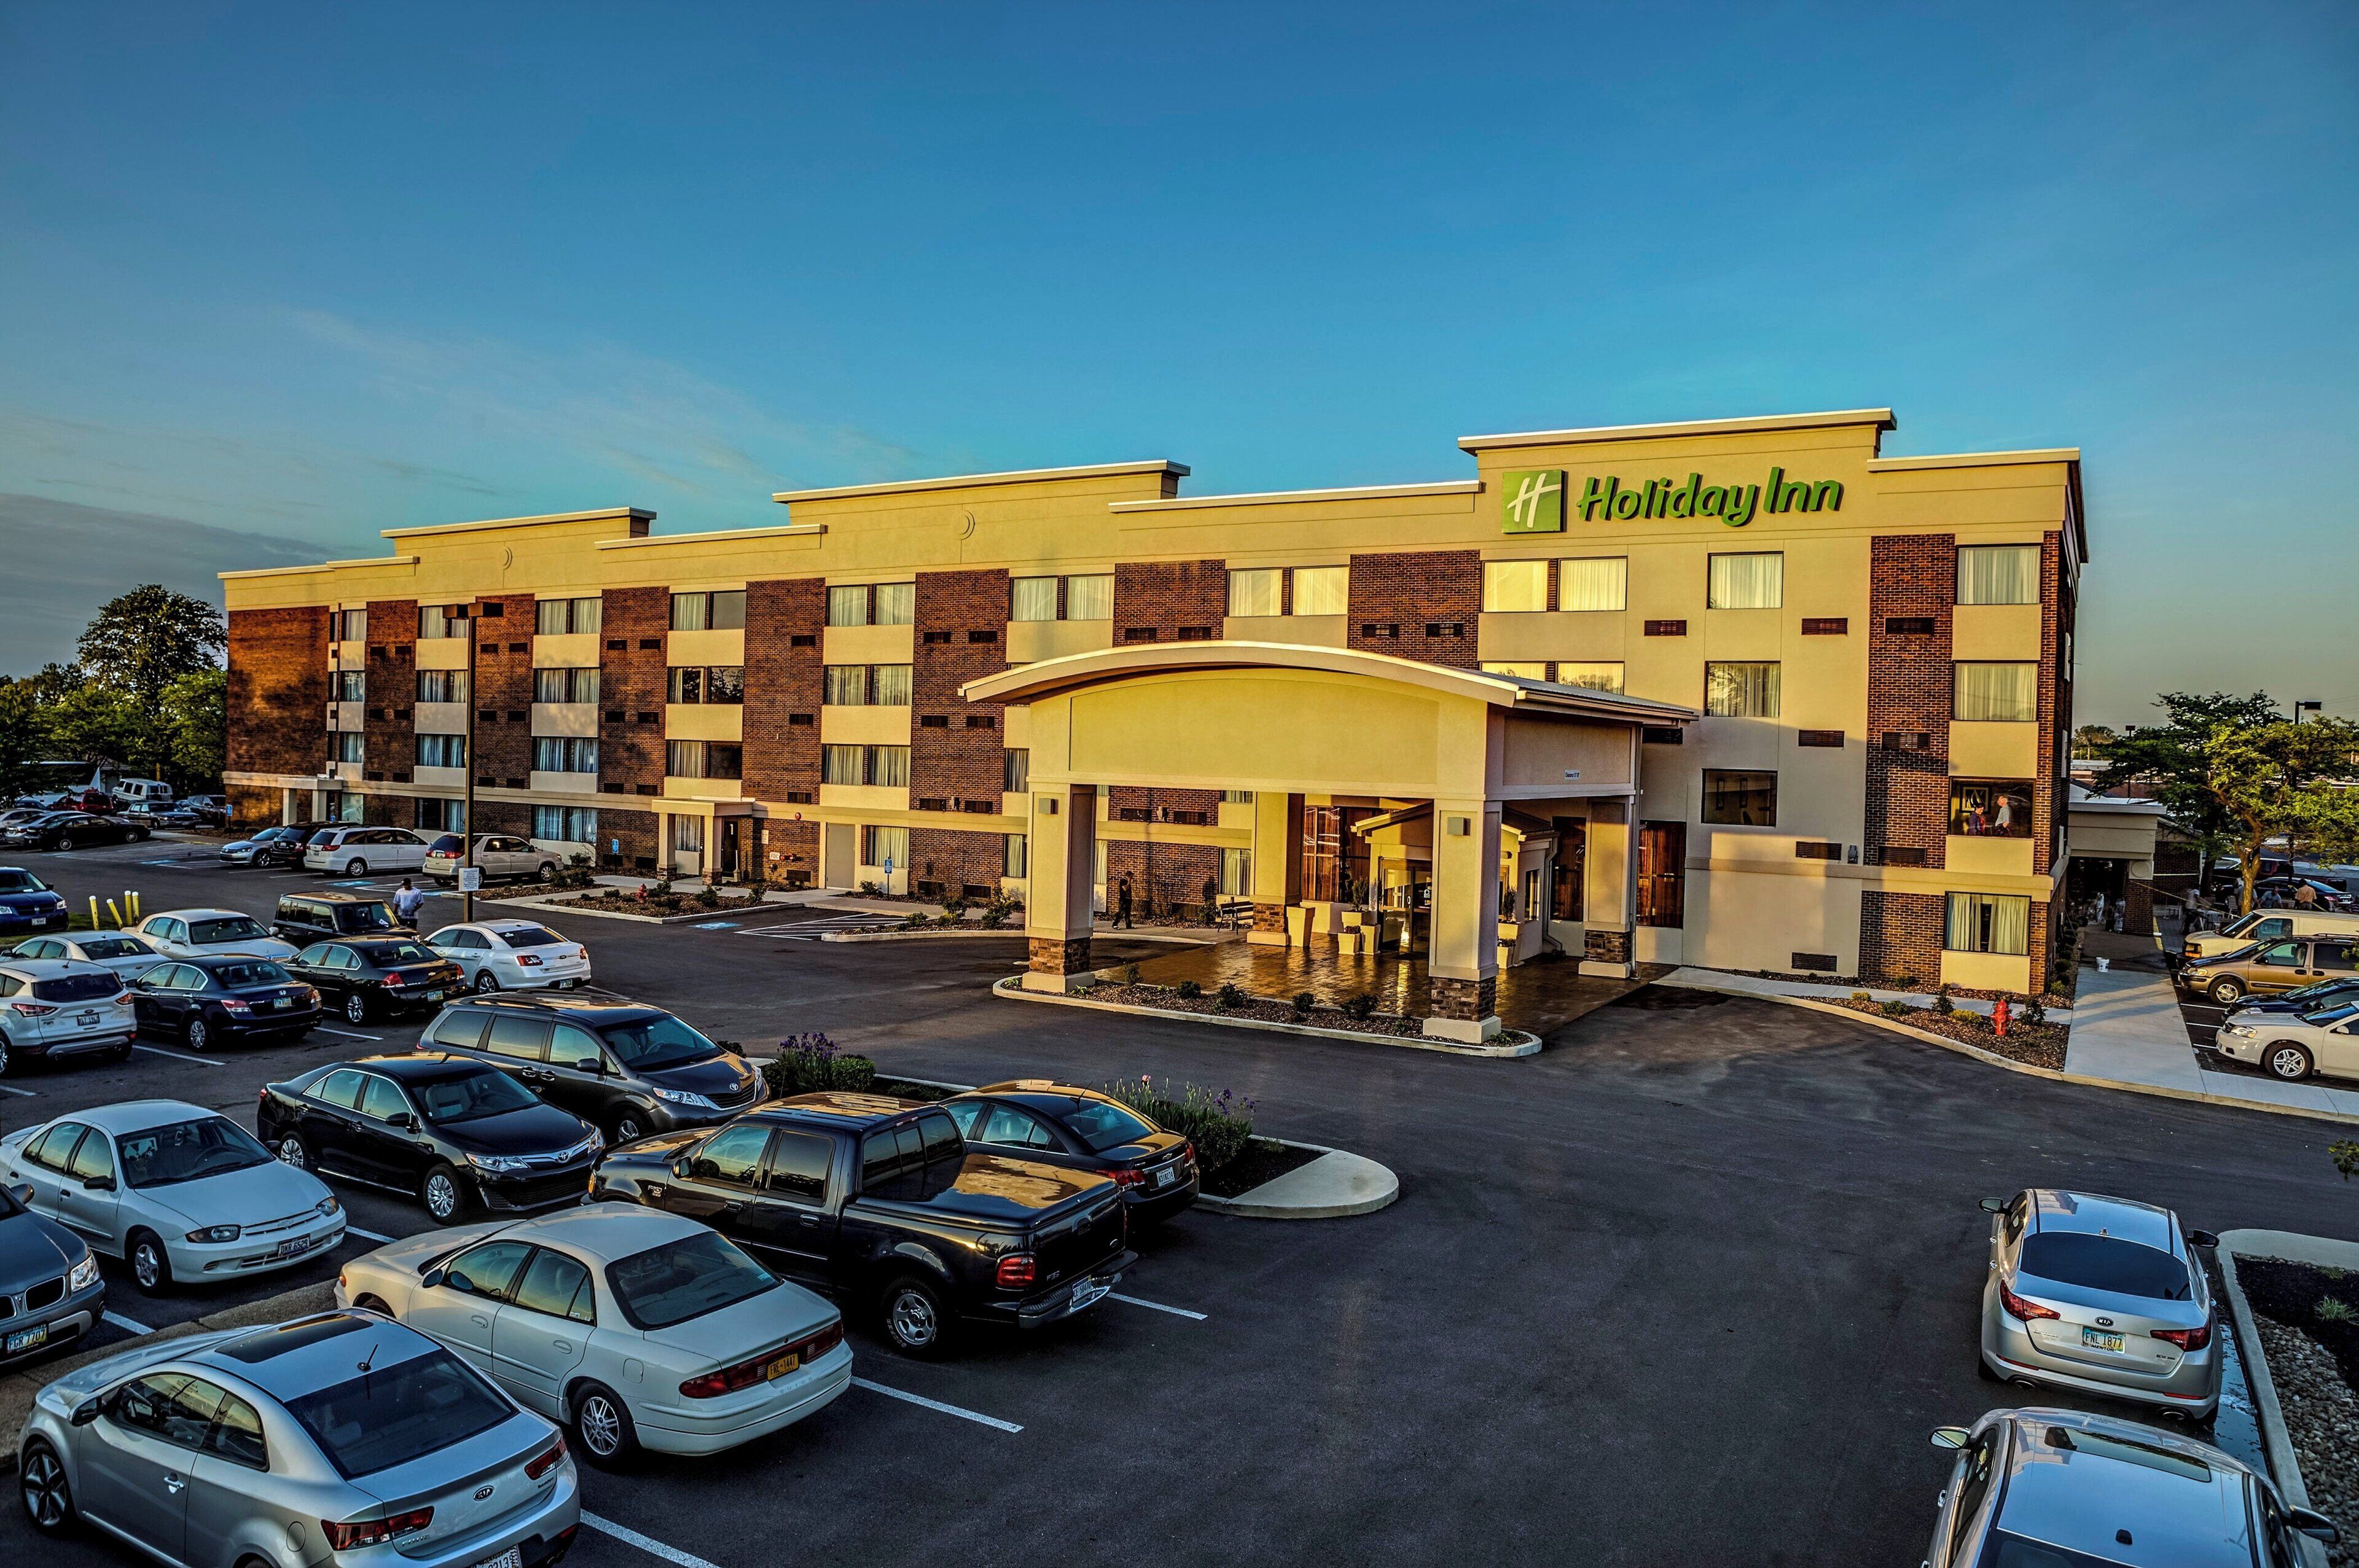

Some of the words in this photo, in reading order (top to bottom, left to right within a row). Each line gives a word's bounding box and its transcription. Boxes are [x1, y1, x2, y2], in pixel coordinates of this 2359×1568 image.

[1576, 472, 1757, 526] Holiday
[1763, 467, 1841, 513] Inn
[730, 824, 734, 835] 1
[9, 1335, 24, 1350] FGR
[26, 1328, 45, 1344] 7707
[2085, 1332, 2100, 1344] FNL
[2102, 1335, 2122, 1348] 1877
[477, 1489, 491, 1499] KIA
